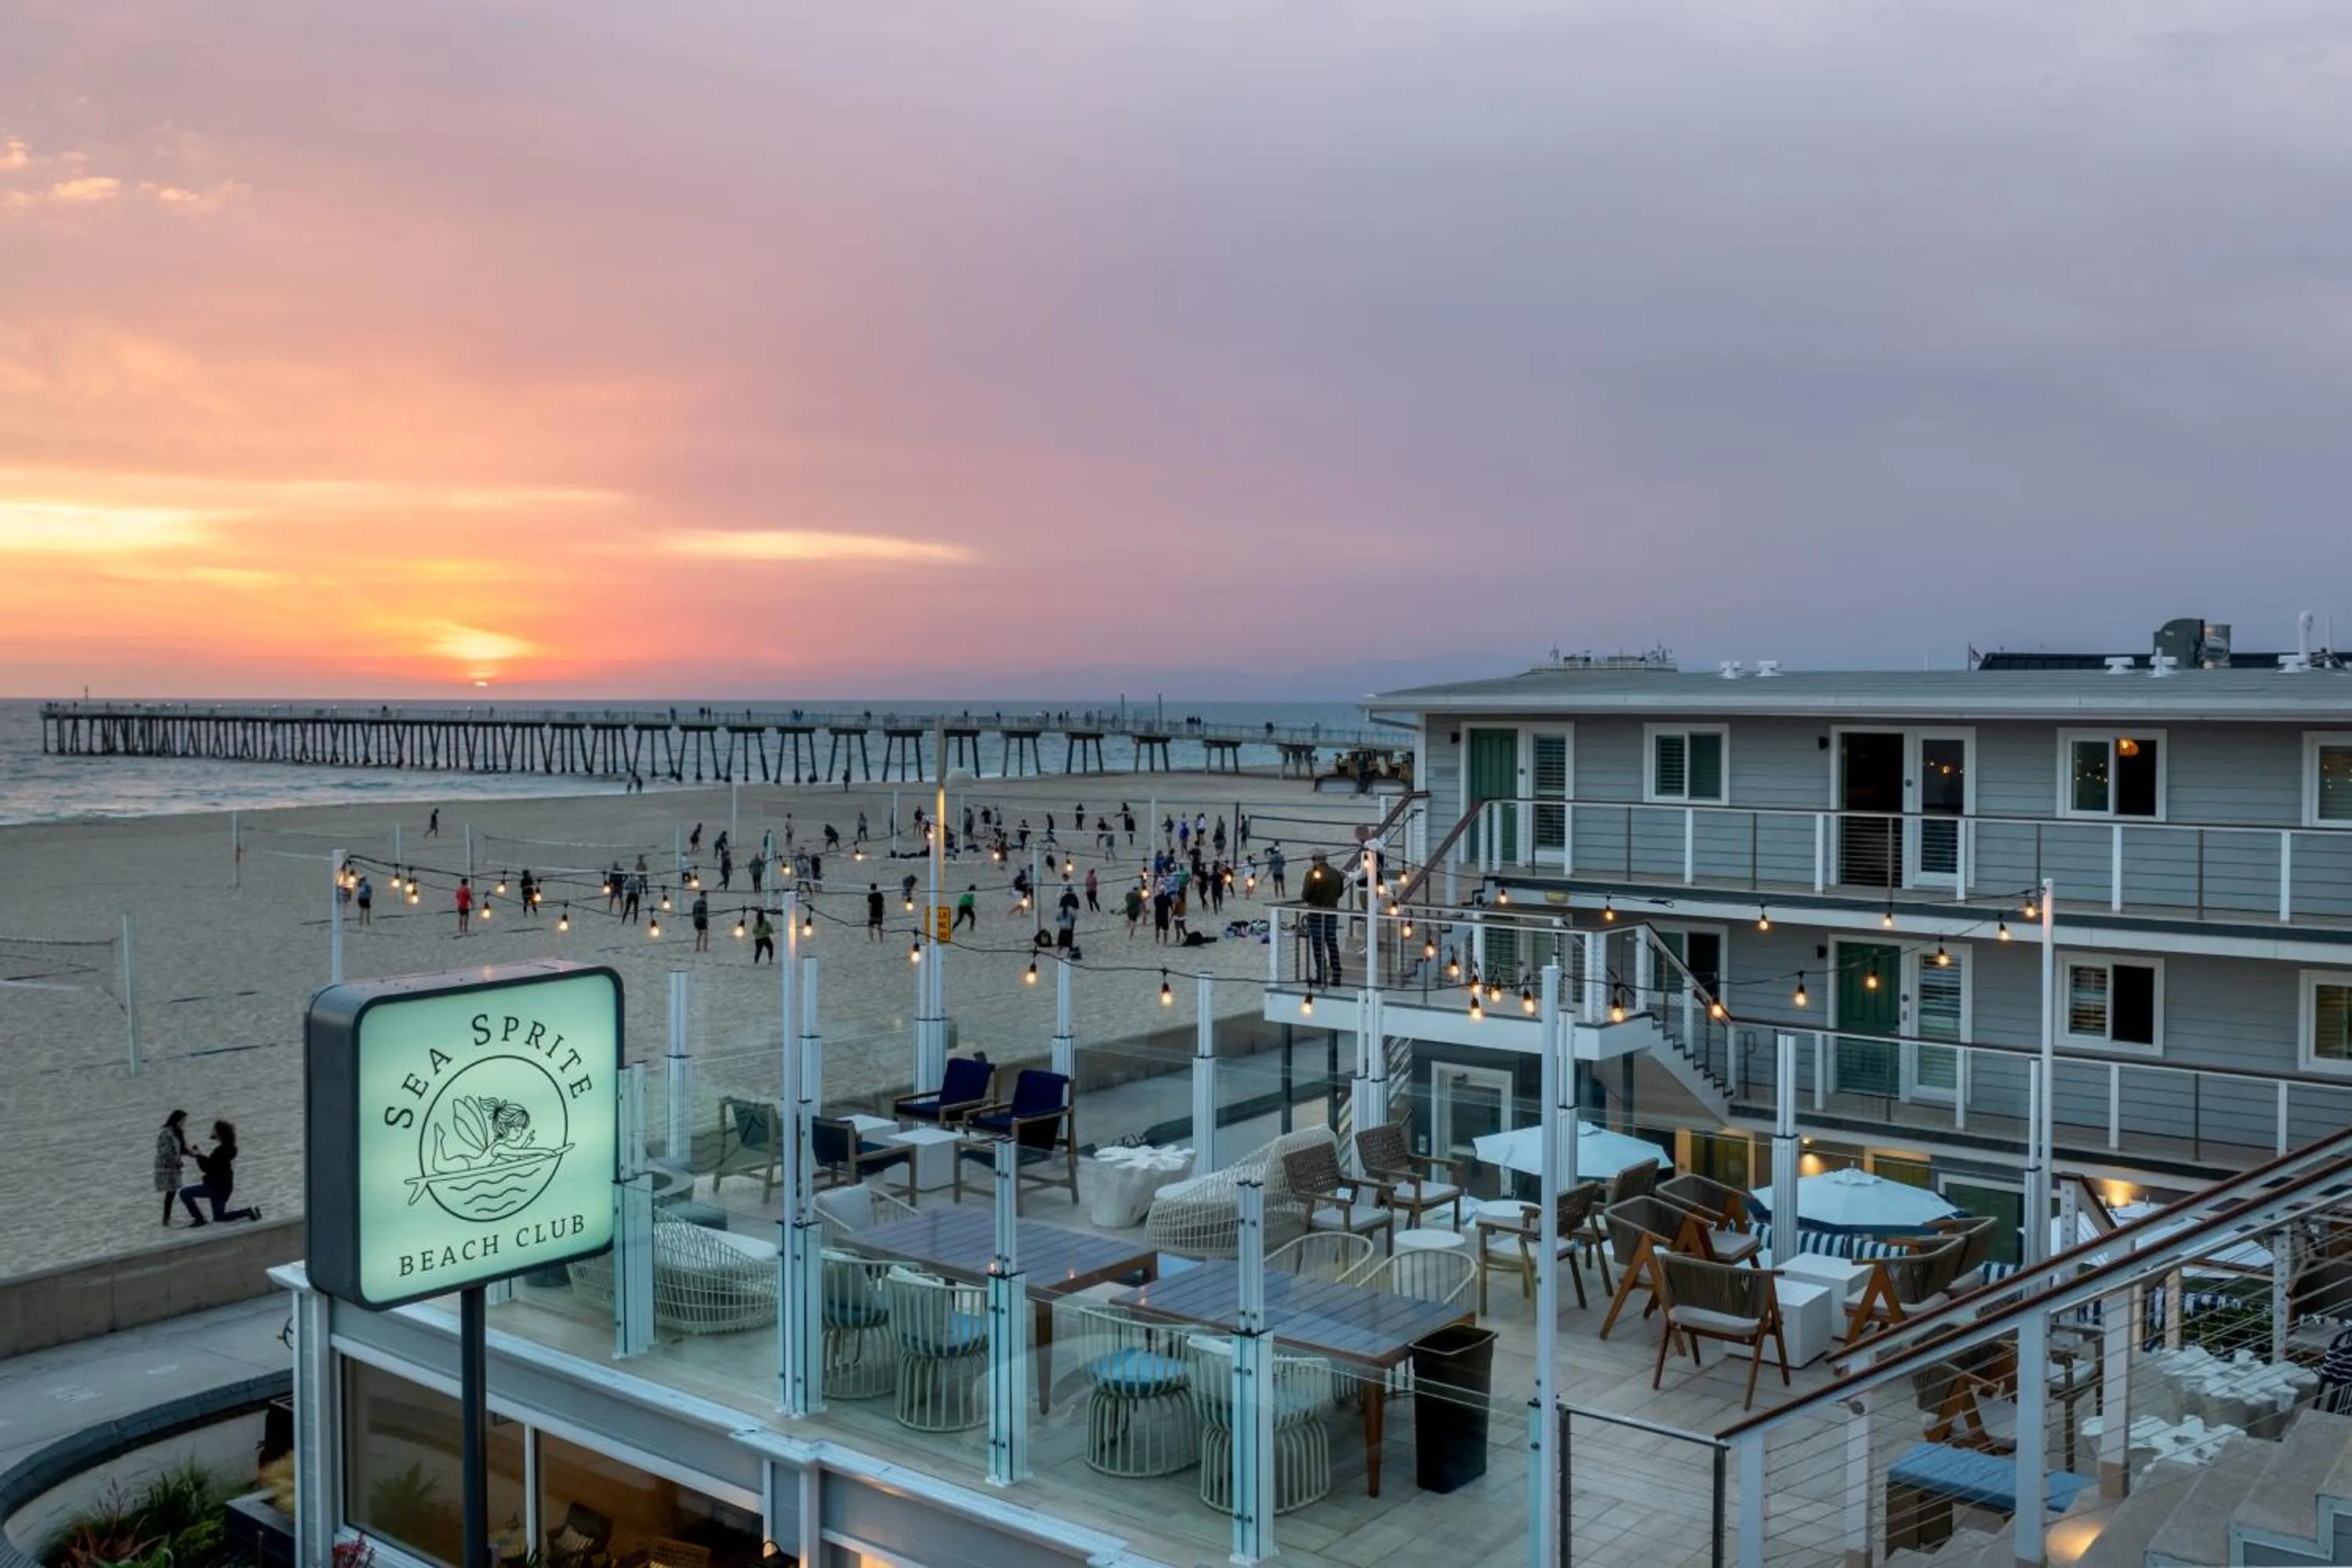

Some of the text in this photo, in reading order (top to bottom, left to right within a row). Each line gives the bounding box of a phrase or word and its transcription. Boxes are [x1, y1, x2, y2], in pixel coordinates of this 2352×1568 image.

[384, 1014, 593, 1129] SEA SPRITE
[398, 1214, 585, 1277] BEACH CLUB
